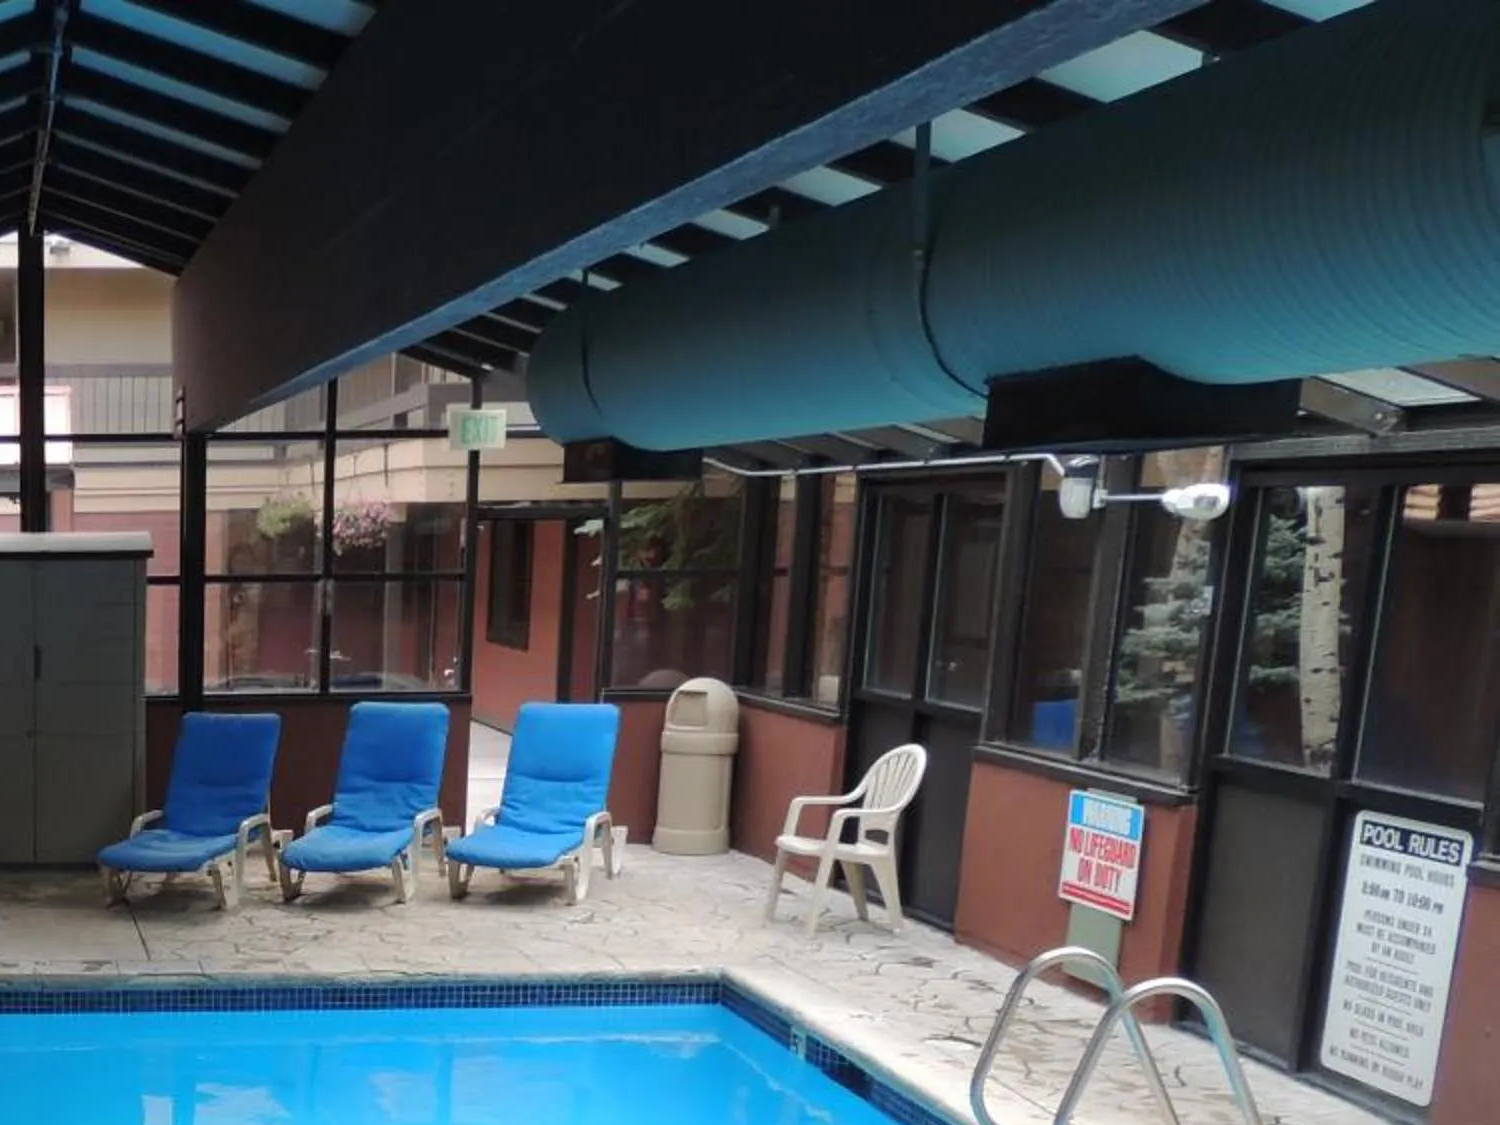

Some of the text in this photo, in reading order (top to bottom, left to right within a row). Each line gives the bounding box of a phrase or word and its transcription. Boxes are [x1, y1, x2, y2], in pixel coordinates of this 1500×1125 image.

[461, 415, 498, 444] EXIT
[1069, 826, 1137, 869] NO LIFEGUARD
[1364, 824, 1459, 863] POOL RULES
[1078, 857, 1122, 893] ON DUTY
[1360, 854, 1400, 874] SWIMMING
[1404, 864, 1424, 879] POOL
[1393, 889, 1404, 902] TO
